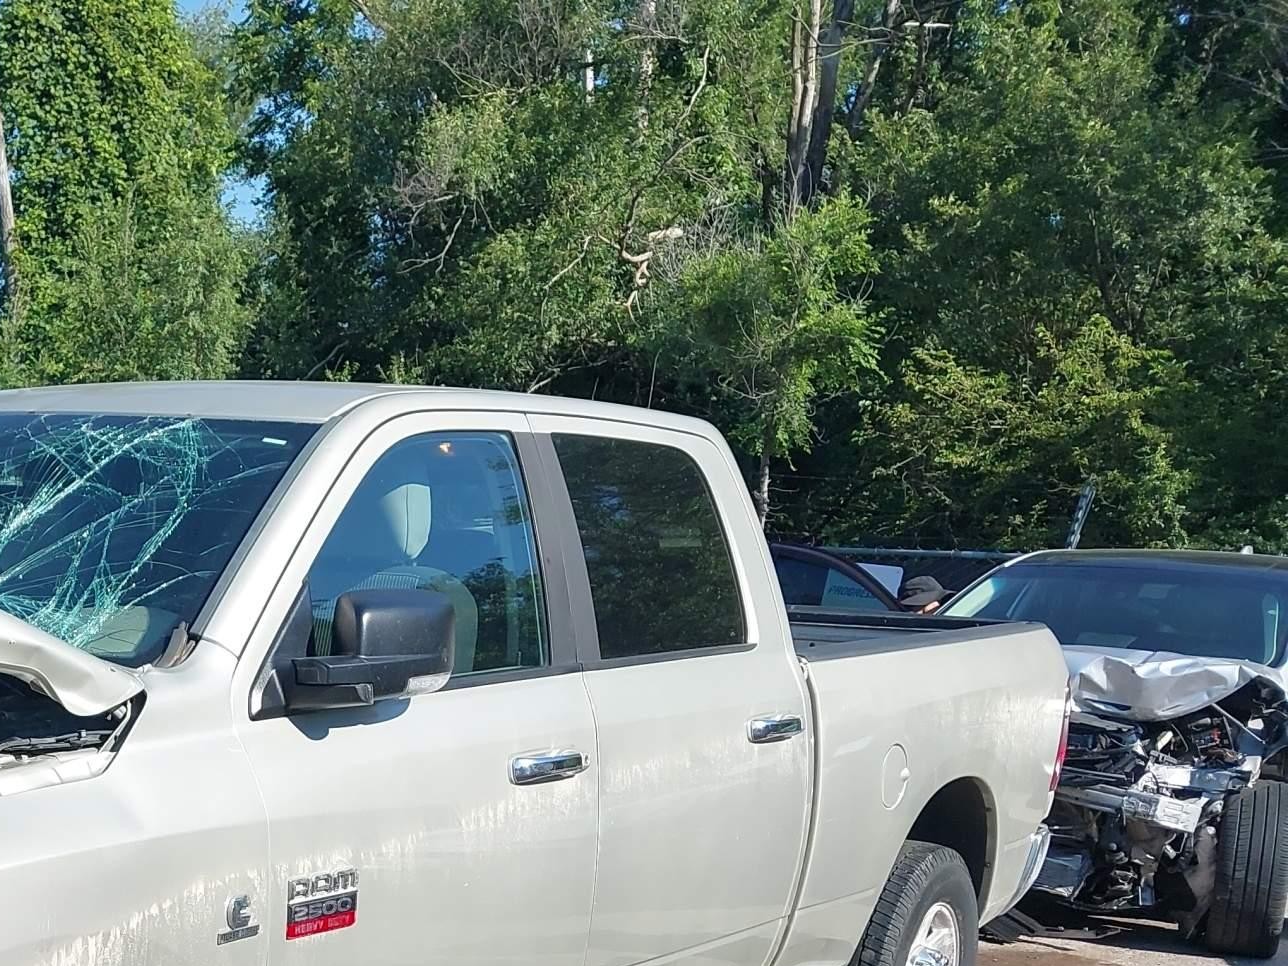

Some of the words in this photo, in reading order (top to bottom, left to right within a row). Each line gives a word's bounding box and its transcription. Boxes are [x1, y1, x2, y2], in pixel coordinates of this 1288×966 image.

[288, 869, 359, 902] RAM
[292, 896, 353, 922] 2500
[294, 919, 324, 936] HEAVY
[327, 914, 351, 928] DUTY
